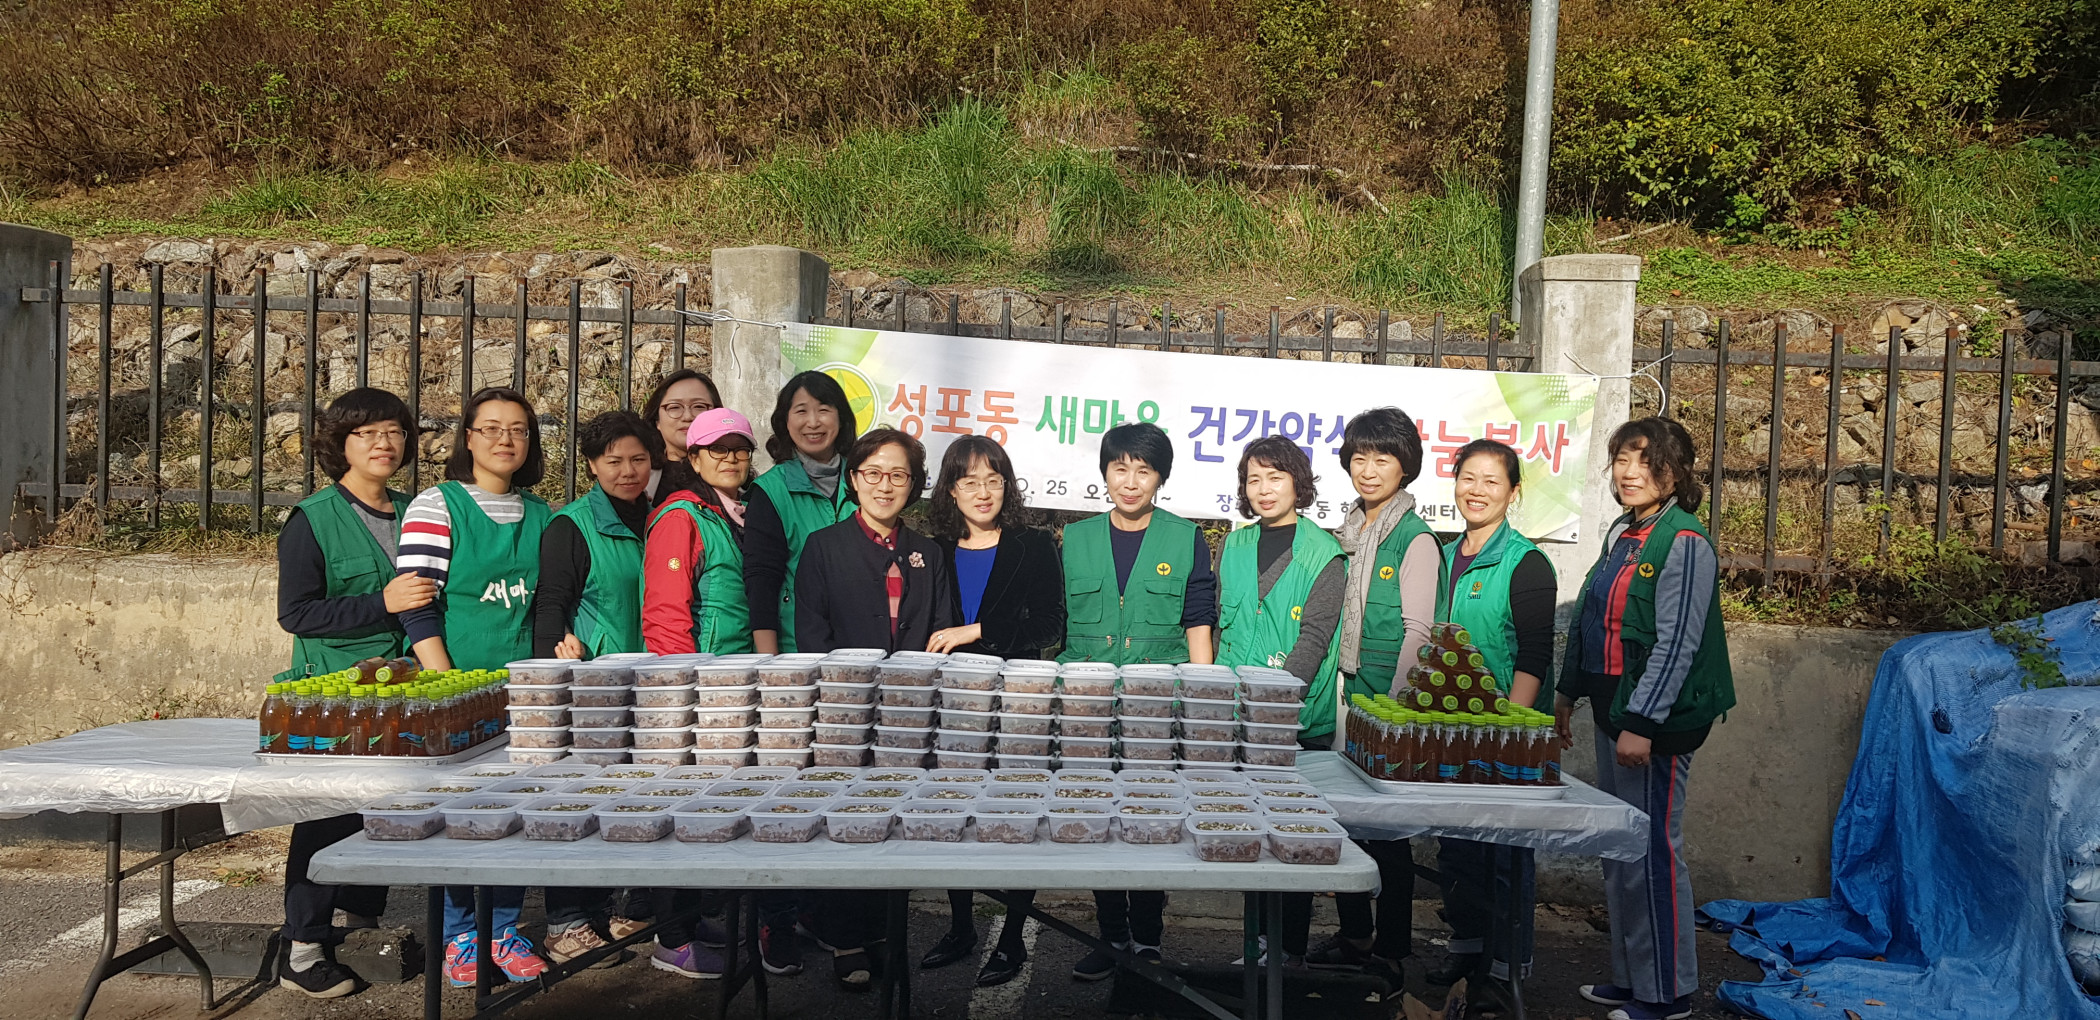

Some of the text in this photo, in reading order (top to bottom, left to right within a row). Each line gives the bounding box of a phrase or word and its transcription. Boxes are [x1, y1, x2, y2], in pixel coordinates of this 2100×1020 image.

[888, 384, 1019, 447] 성포동
[1046, 480, 1068, 496] 25
[1216, 494, 1241, 513] 장
[480, 577, 538, 609] 새마
